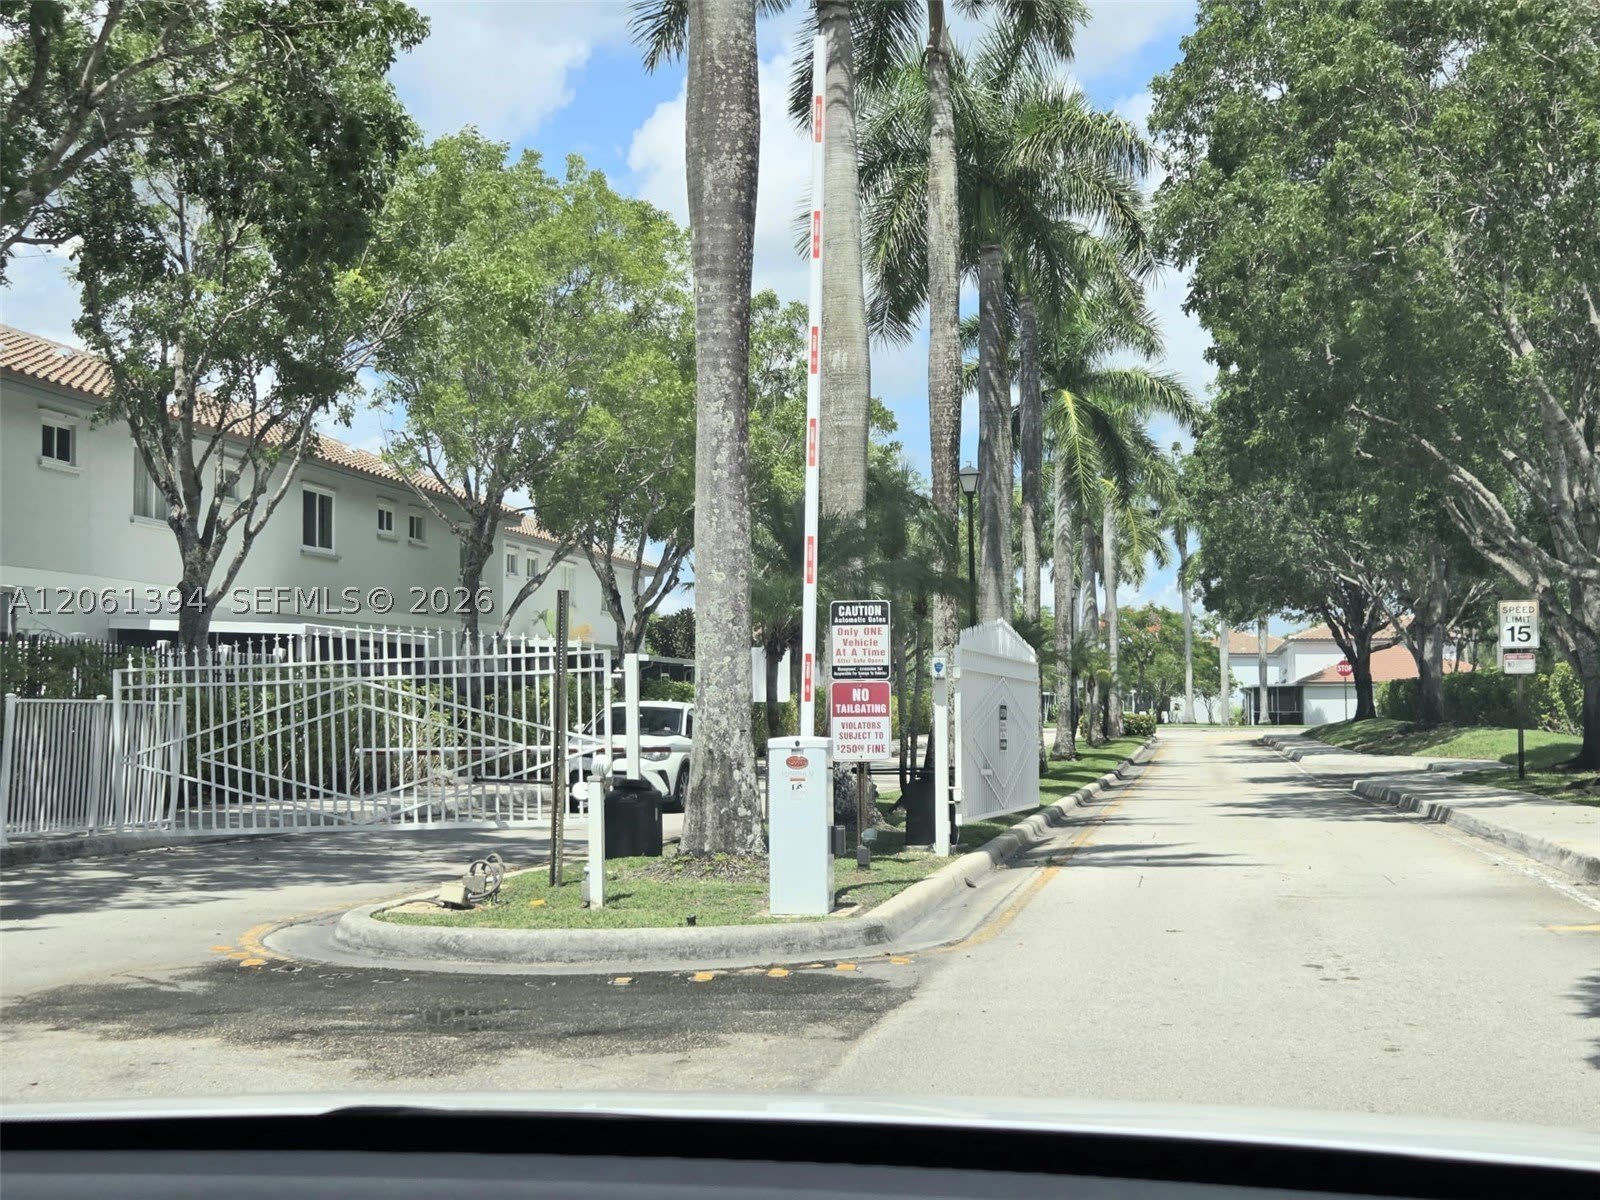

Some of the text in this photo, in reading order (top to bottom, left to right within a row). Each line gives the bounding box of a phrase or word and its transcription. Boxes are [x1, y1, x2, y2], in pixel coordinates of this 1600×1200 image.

[838, 605, 882, 617] CAUTION
[1502, 606, 1535, 614] SPEED
[837, 626, 883, 637] Only ONE
[1506, 625, 1532, 642] 15
[842, 638, 879, 647] Vehicle
[836, 648, 886, 657] At A Time
[1337, 664, 1353, 672] STOP
[852, 688, 870, 702] NO
[835, 704, 887, 714] TAILGATING
[841, 722, 882, 730] VIOLATORS
[838, 731, 884, 740] SUBJECT TO
[867, 744, 887, 753] FINE
